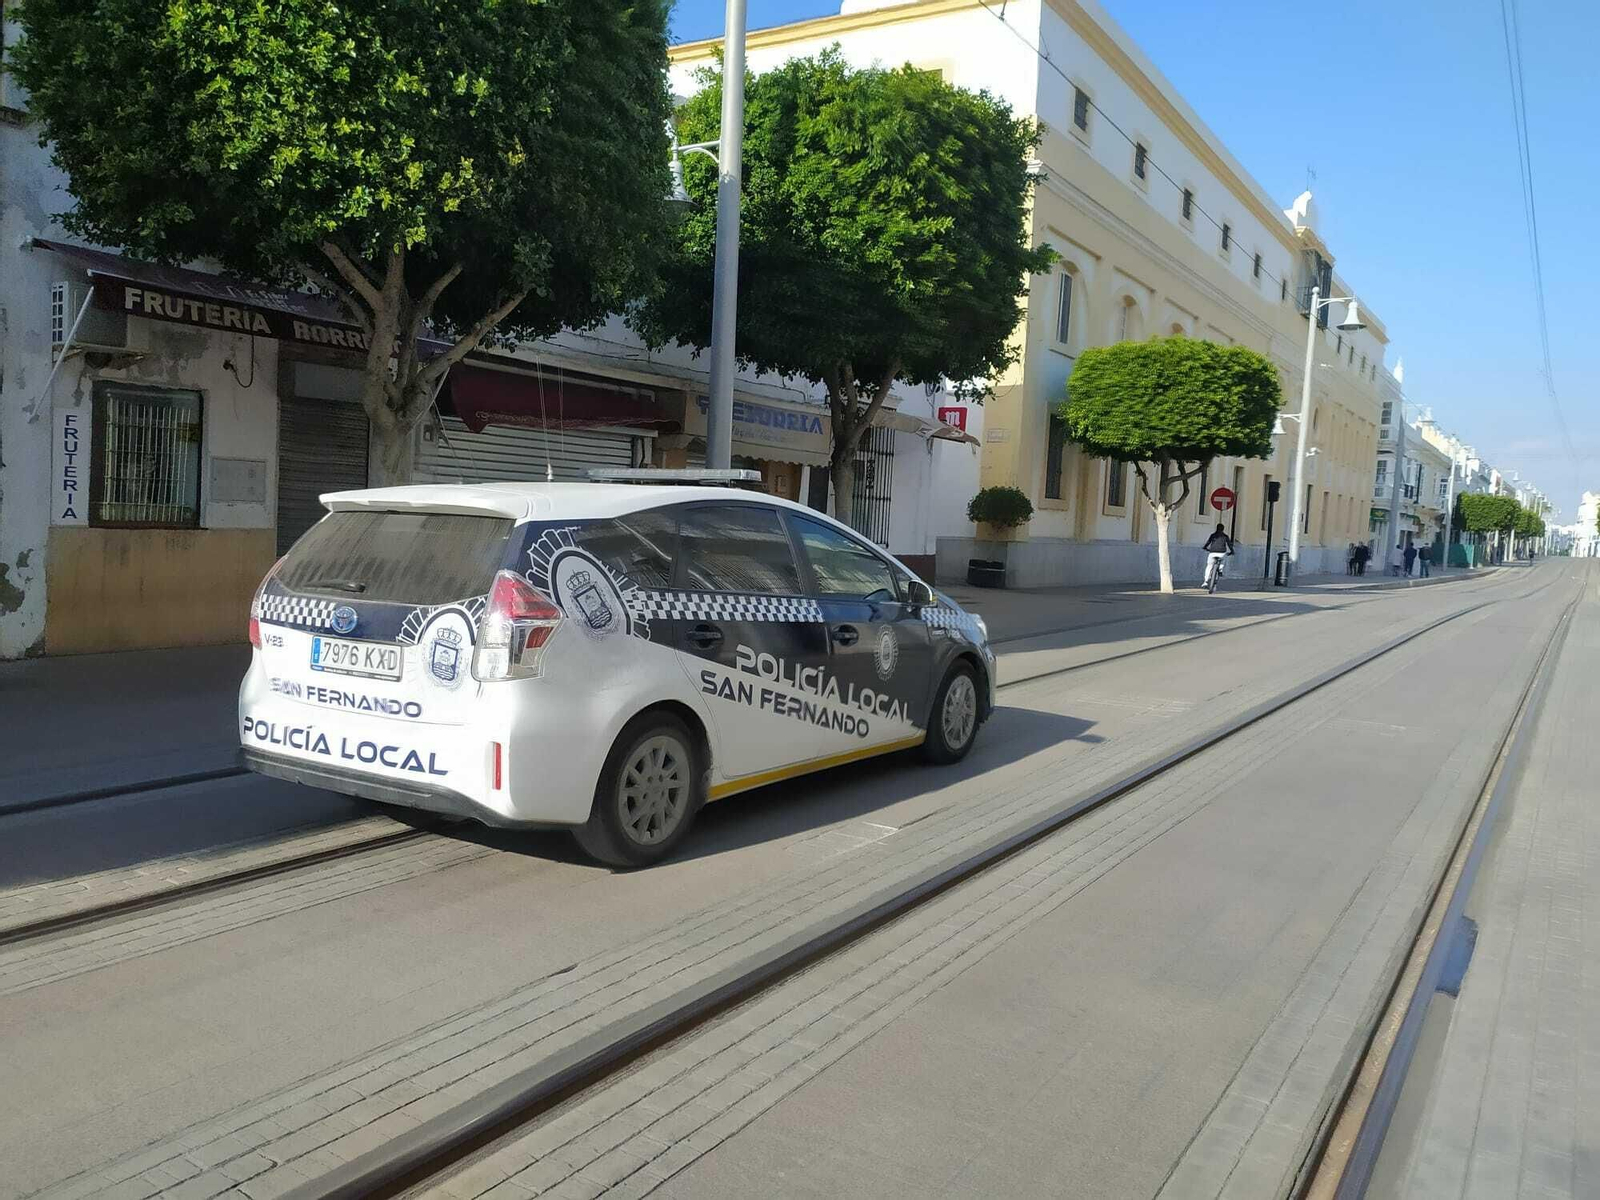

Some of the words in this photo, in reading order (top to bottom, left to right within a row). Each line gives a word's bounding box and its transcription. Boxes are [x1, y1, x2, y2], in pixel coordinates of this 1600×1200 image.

[62, 414, 78, 519] FRUTERIA
[322, 641, 360, 667] 7976
[364, 646, 398, 671] KXD
[735, 643, 840, 701] POLICÍA
[849, 682, 913, 726] LOCAL
[269, 677, 301, 699] SAN
[306, 685, 422, 718] FERNANDO
[700, 669, 754, 706] SAN
[759, 687, 870, 739] FERNANDO
[243, 715, 331, 756] POLICÍA
[340, 736, 449, 776] LOCAL
